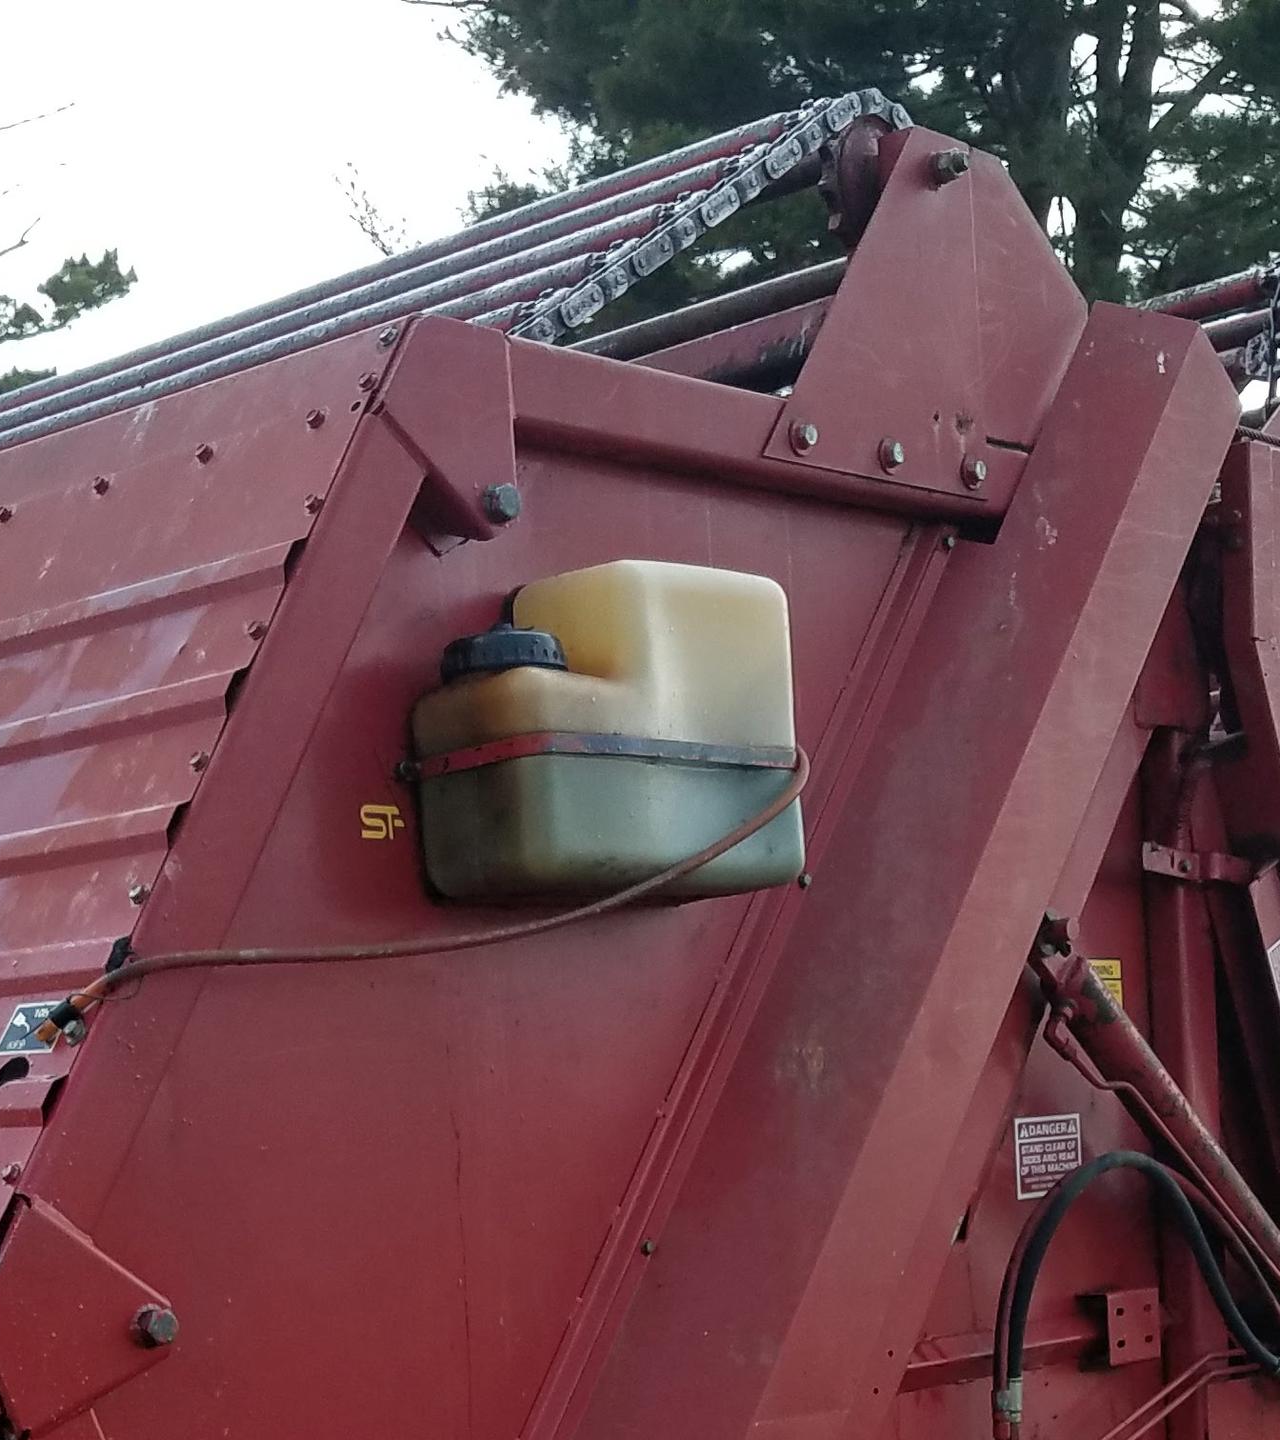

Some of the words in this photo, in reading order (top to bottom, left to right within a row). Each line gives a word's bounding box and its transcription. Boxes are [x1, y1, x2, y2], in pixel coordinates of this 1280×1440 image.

[1028, 1122, 1067, 1136] DANGER
[1021, 1144, 1044, 1154] STAND
[1045, 1142, 1066, 1152] CLEAR
[1067, 1141, 1076, 1150] OF
[1042, 1153, 1057, 1162] AND
[1058, 1151, 1076, 1160] REAR
[1021, 1166, 1029, 1176] OF
